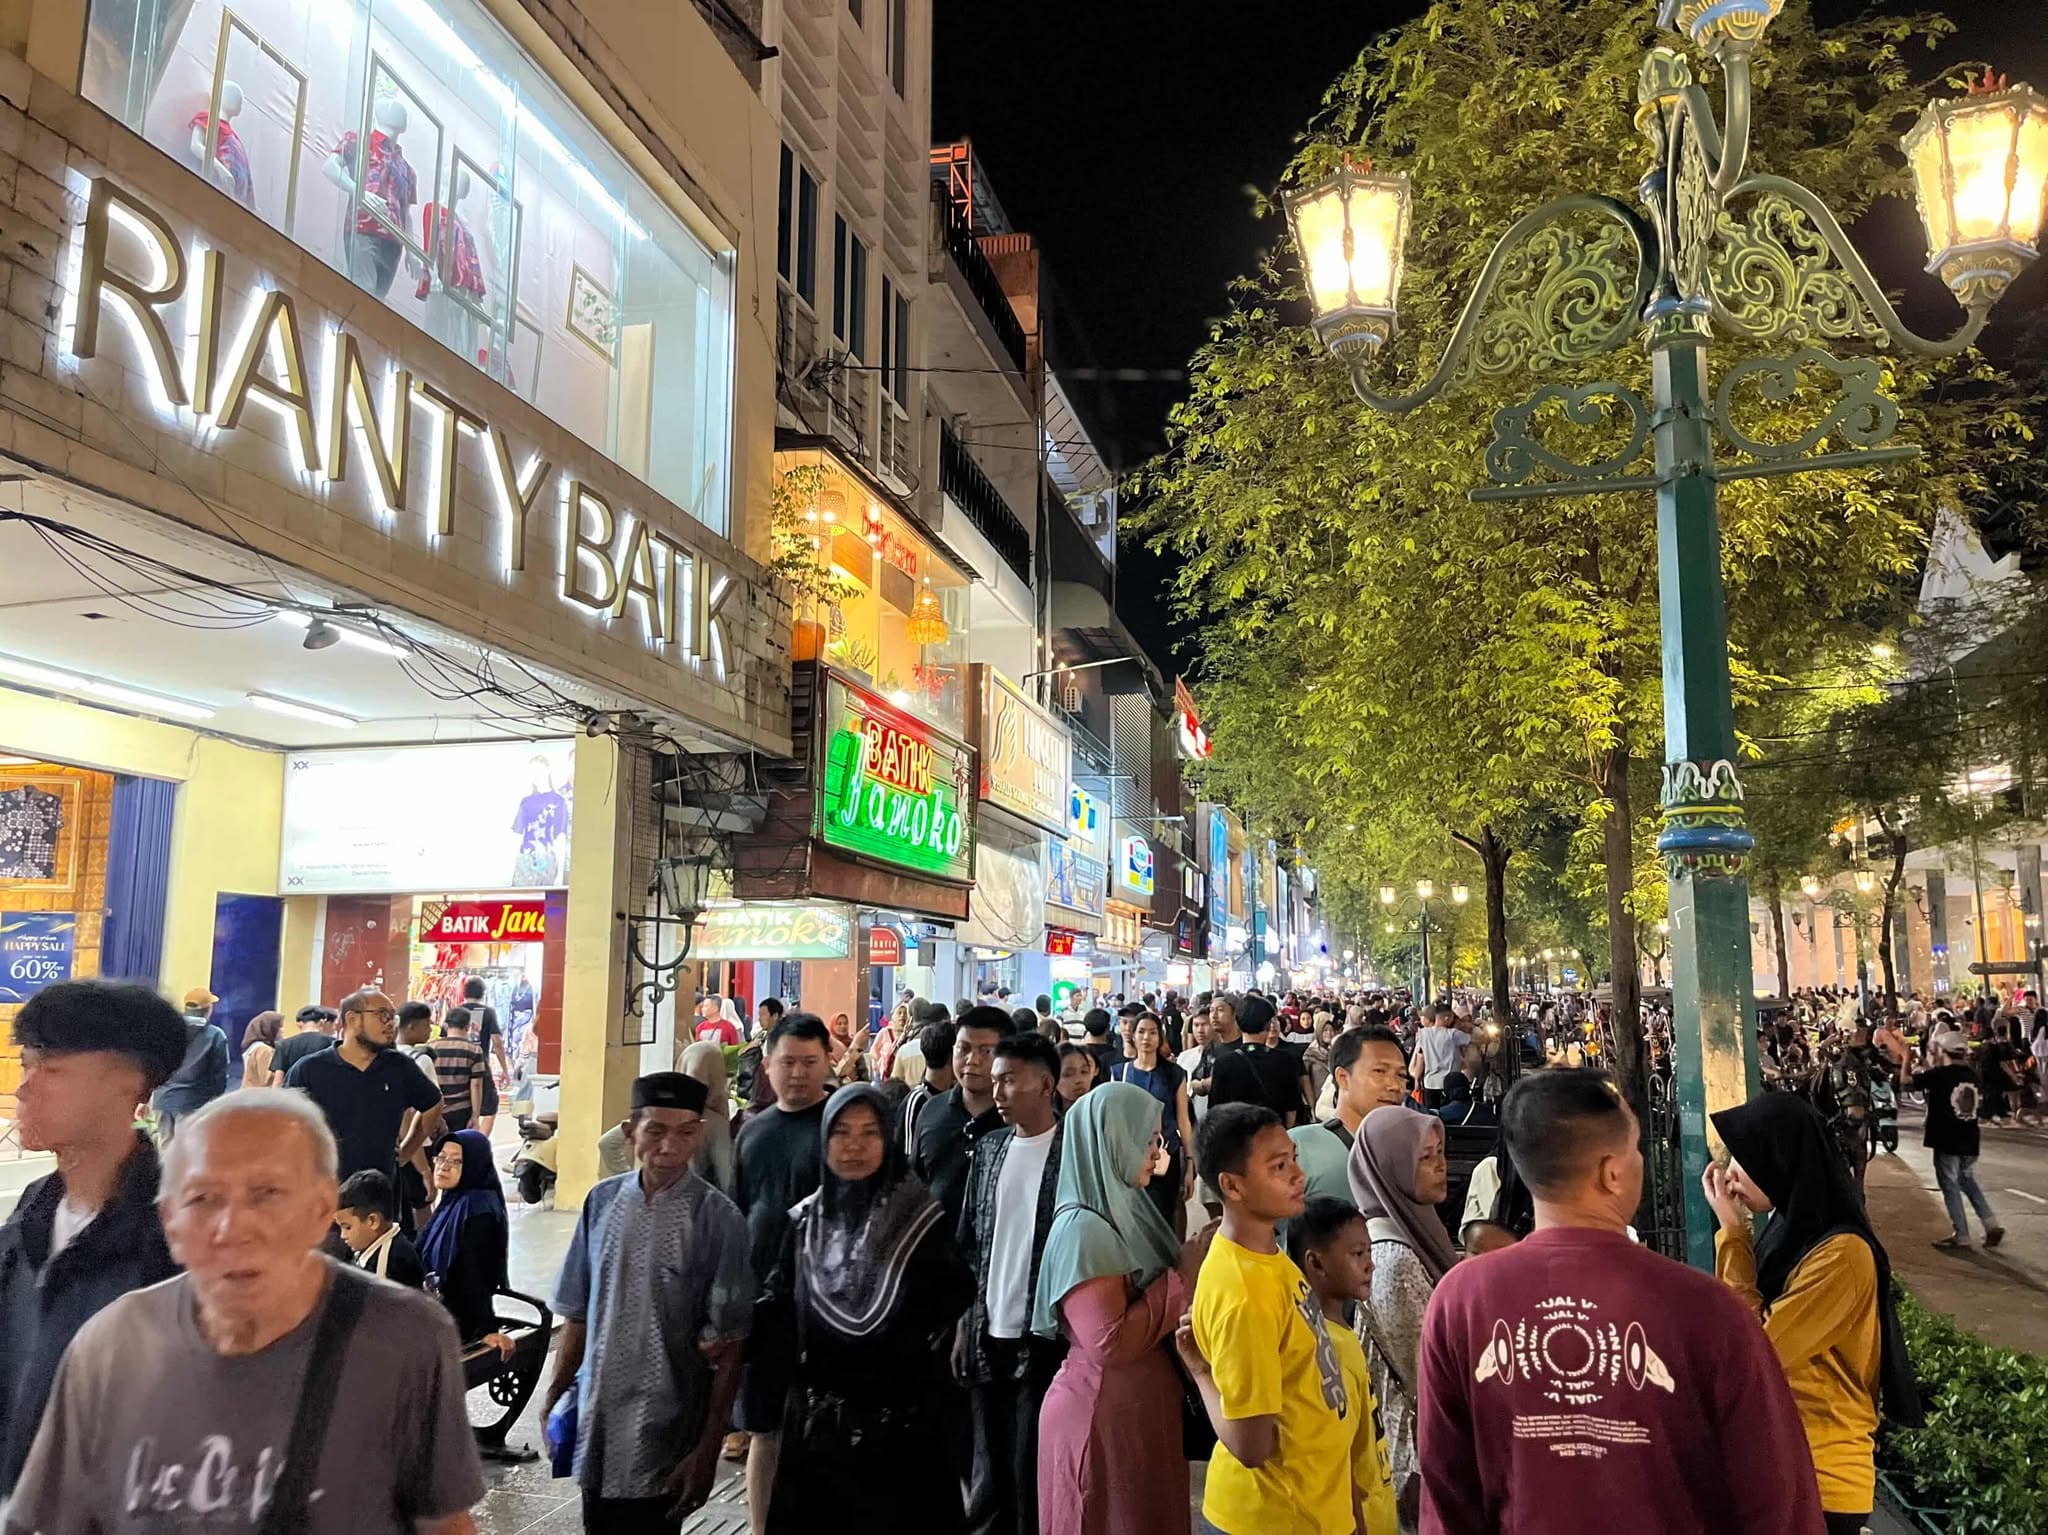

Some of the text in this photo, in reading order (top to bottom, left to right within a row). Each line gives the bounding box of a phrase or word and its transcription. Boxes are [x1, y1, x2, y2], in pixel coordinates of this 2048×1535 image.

[72, 176, 741, 675] RIANTY BATIK
[866, 718, 934, 793] BATIK
[441, 915, 490, 934] BATIK
[717, 910, 794, 926] BATIK
[4, 941, 40, 952] HAPPY
[10, 959, 59, 980] 60%
[1535, 1295, 1599, 1309] UAL V
[1542, 1309, 1591, 1321] UAL V
[1515, 1317, 1527, 1349] UN
[1529, 1324, 1539, 1349] UN
[1598, 1352, 1609, 1377] UN
[1610, 1354, 1622, 1387] UN
[1565, 1380, 1596, 1390] UAL
[1543, 1391, 1604, 1406] UAL V
